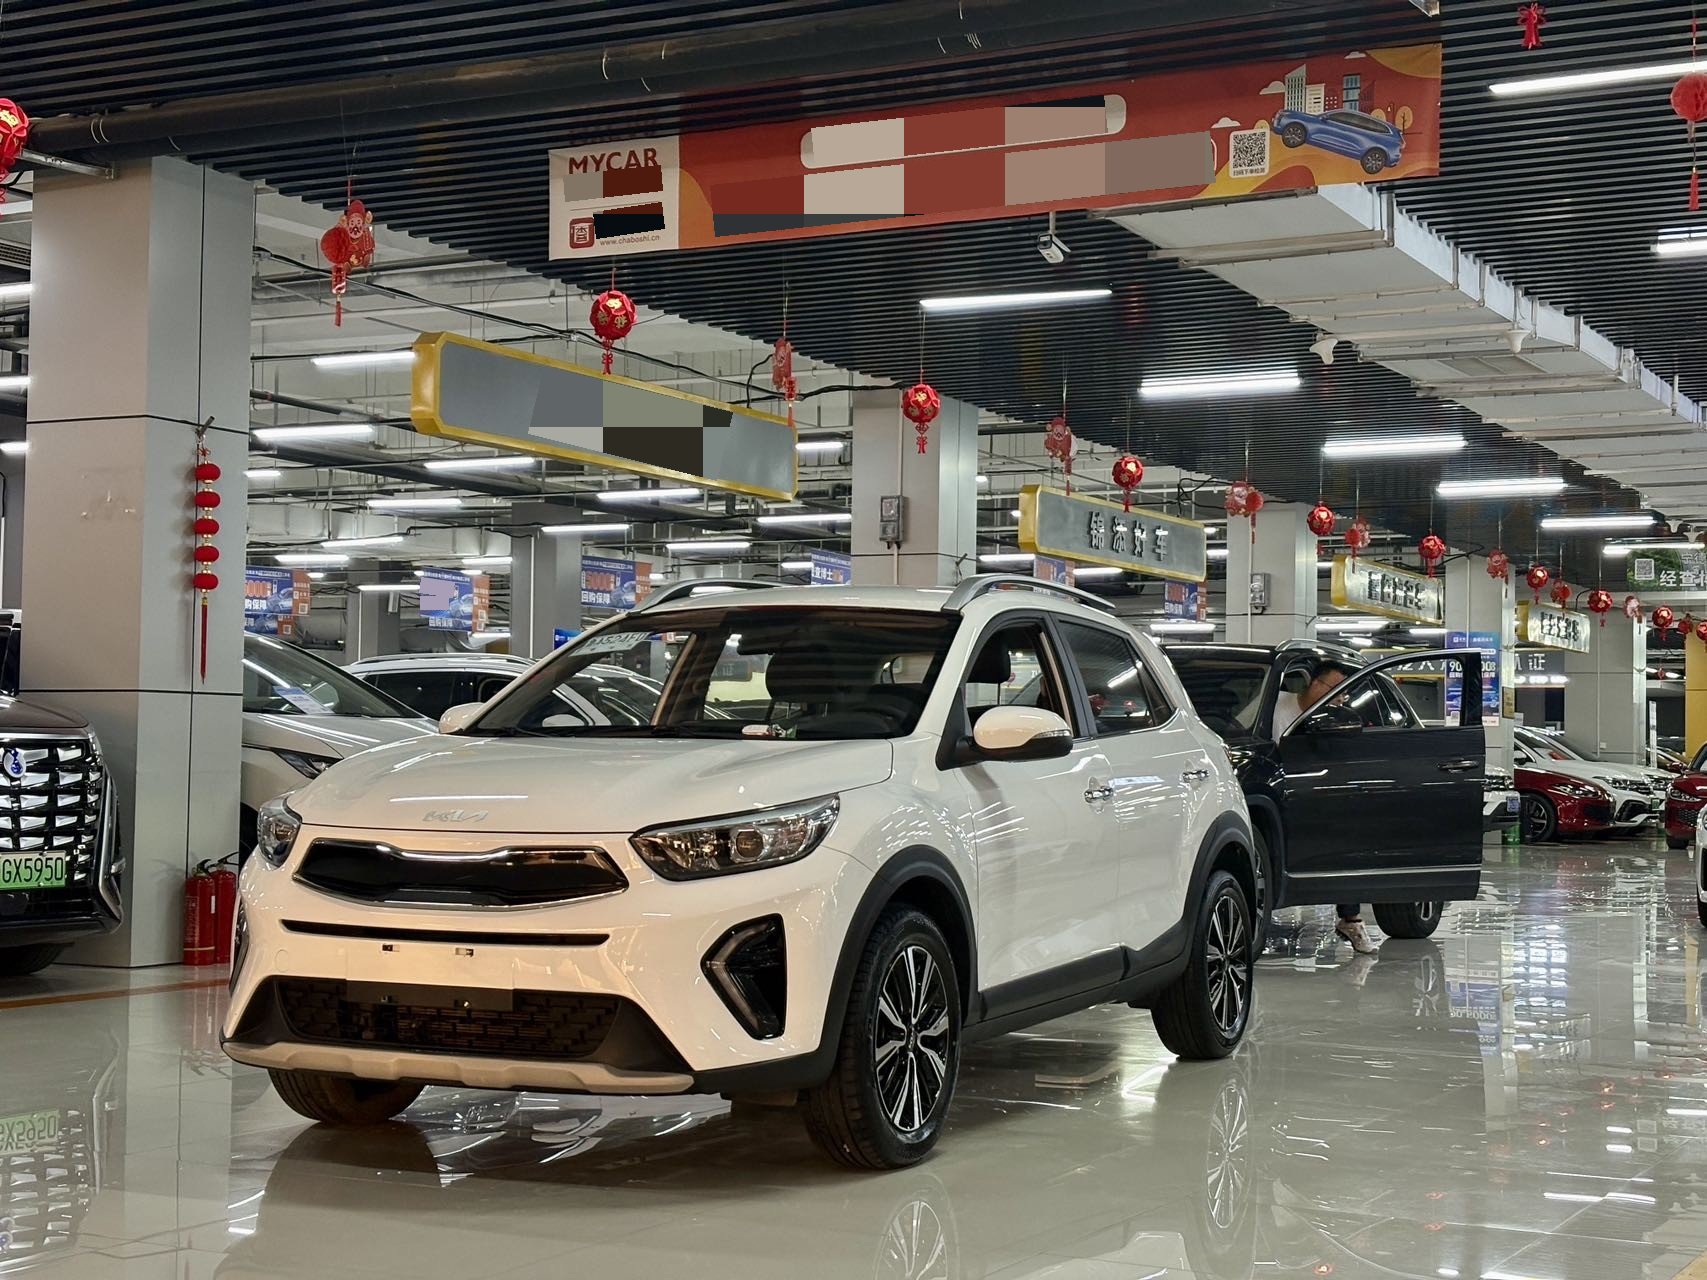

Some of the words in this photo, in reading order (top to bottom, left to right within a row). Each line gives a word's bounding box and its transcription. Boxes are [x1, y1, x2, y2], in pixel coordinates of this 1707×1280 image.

[569, 148, 658, 174] MYCAR
[600, 235, 660, 246] www.chaboshi.cn
[811, 566, 833, 580] 查博士
[2, 857, 64, 884] GX5950
